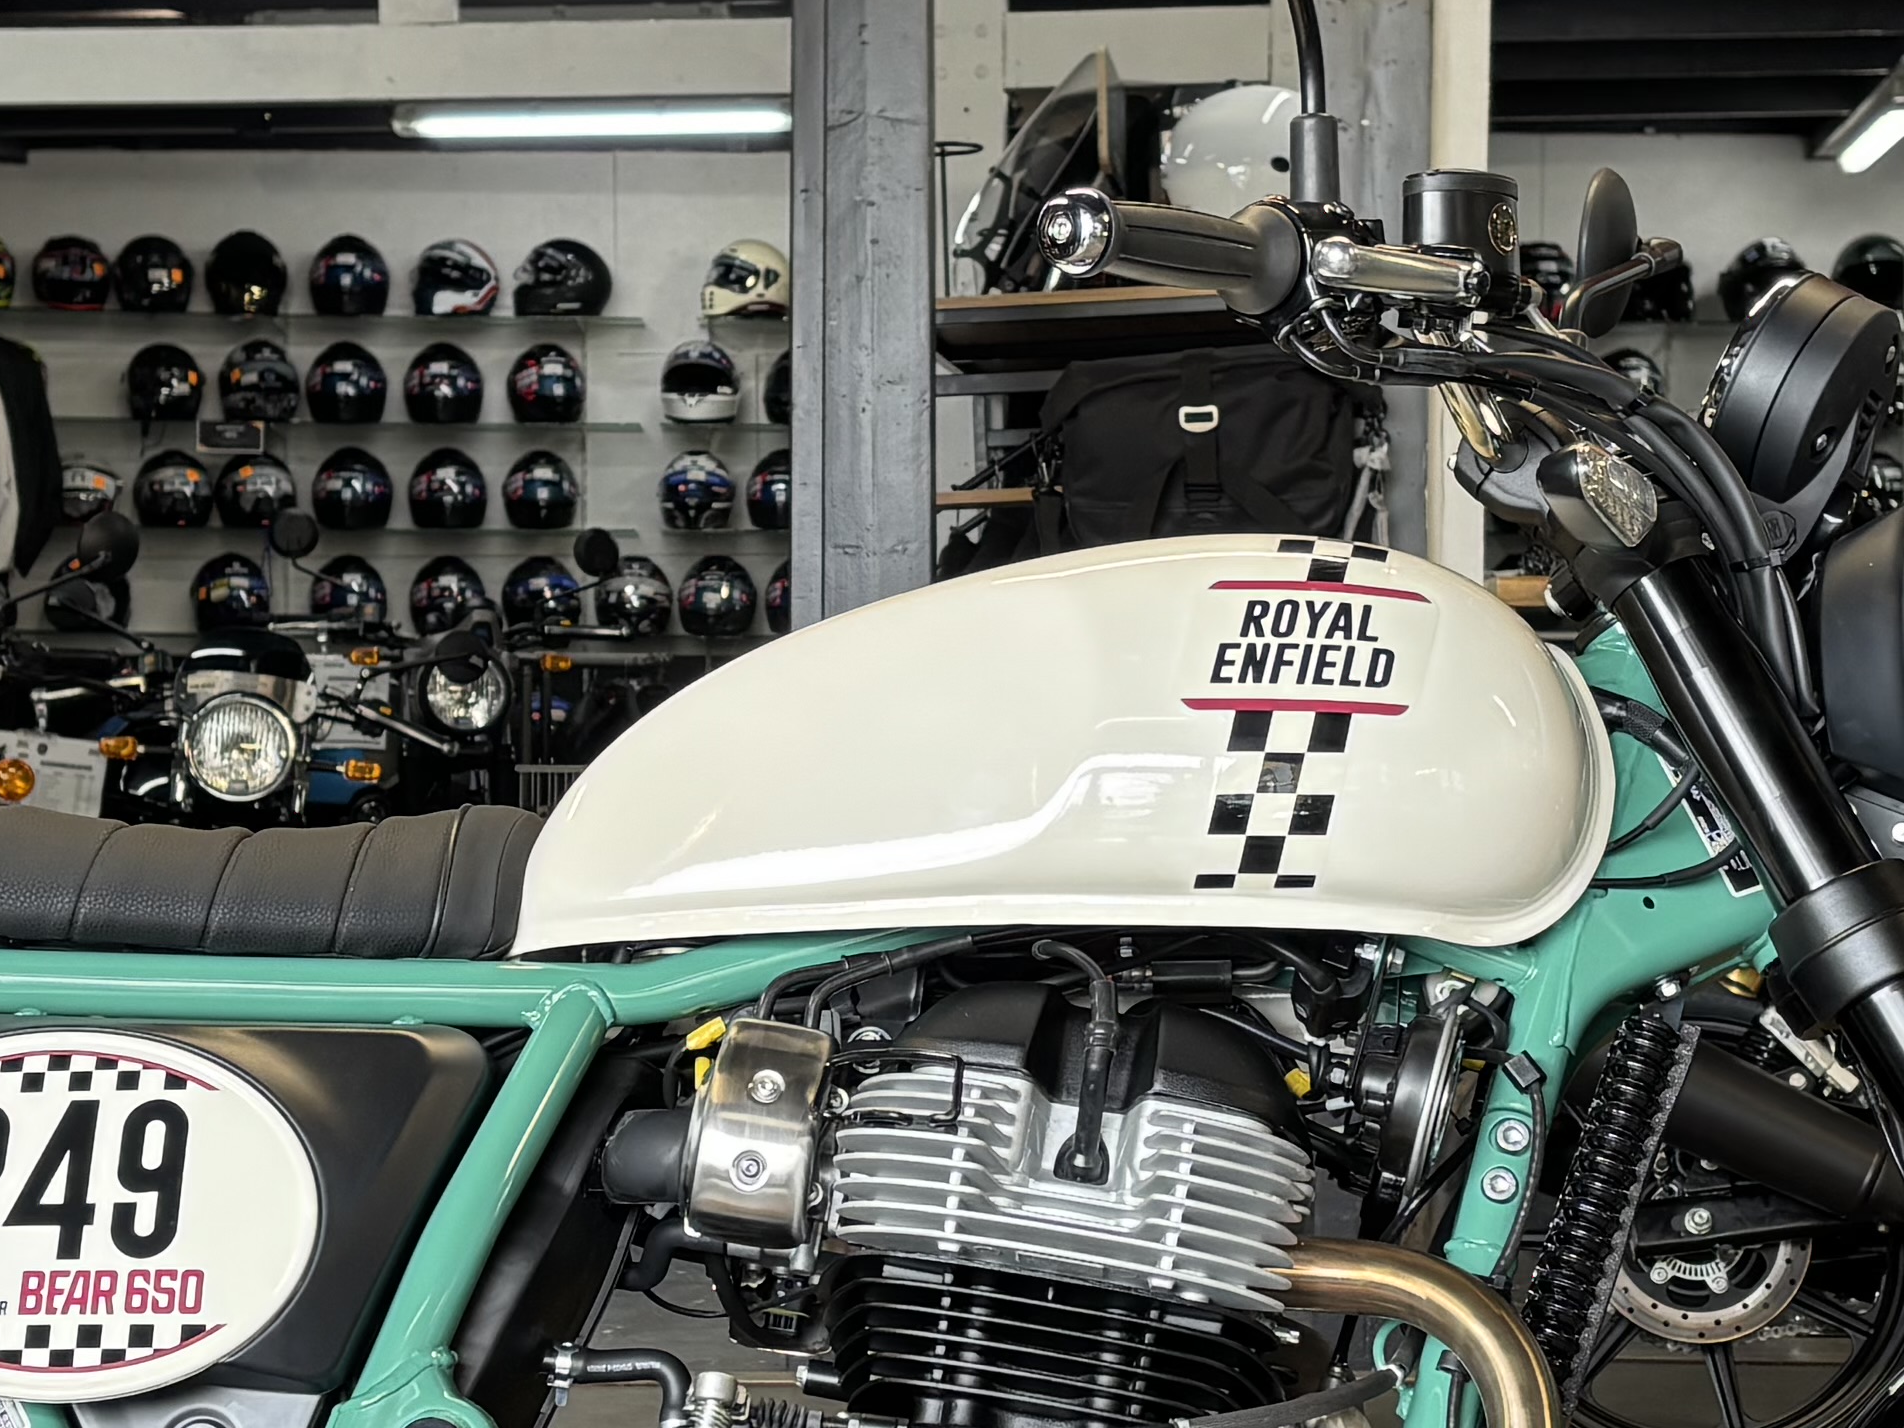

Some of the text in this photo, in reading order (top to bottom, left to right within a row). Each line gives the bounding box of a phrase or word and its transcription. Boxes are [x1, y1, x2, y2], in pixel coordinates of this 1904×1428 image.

[1239, 600, 1379, 642] ROYAL
[1209, 643, 1395, 689] ENFIELD
[18, 1270, 118, 1316] BEAR
[124, 1269, 205, 1315] 650
